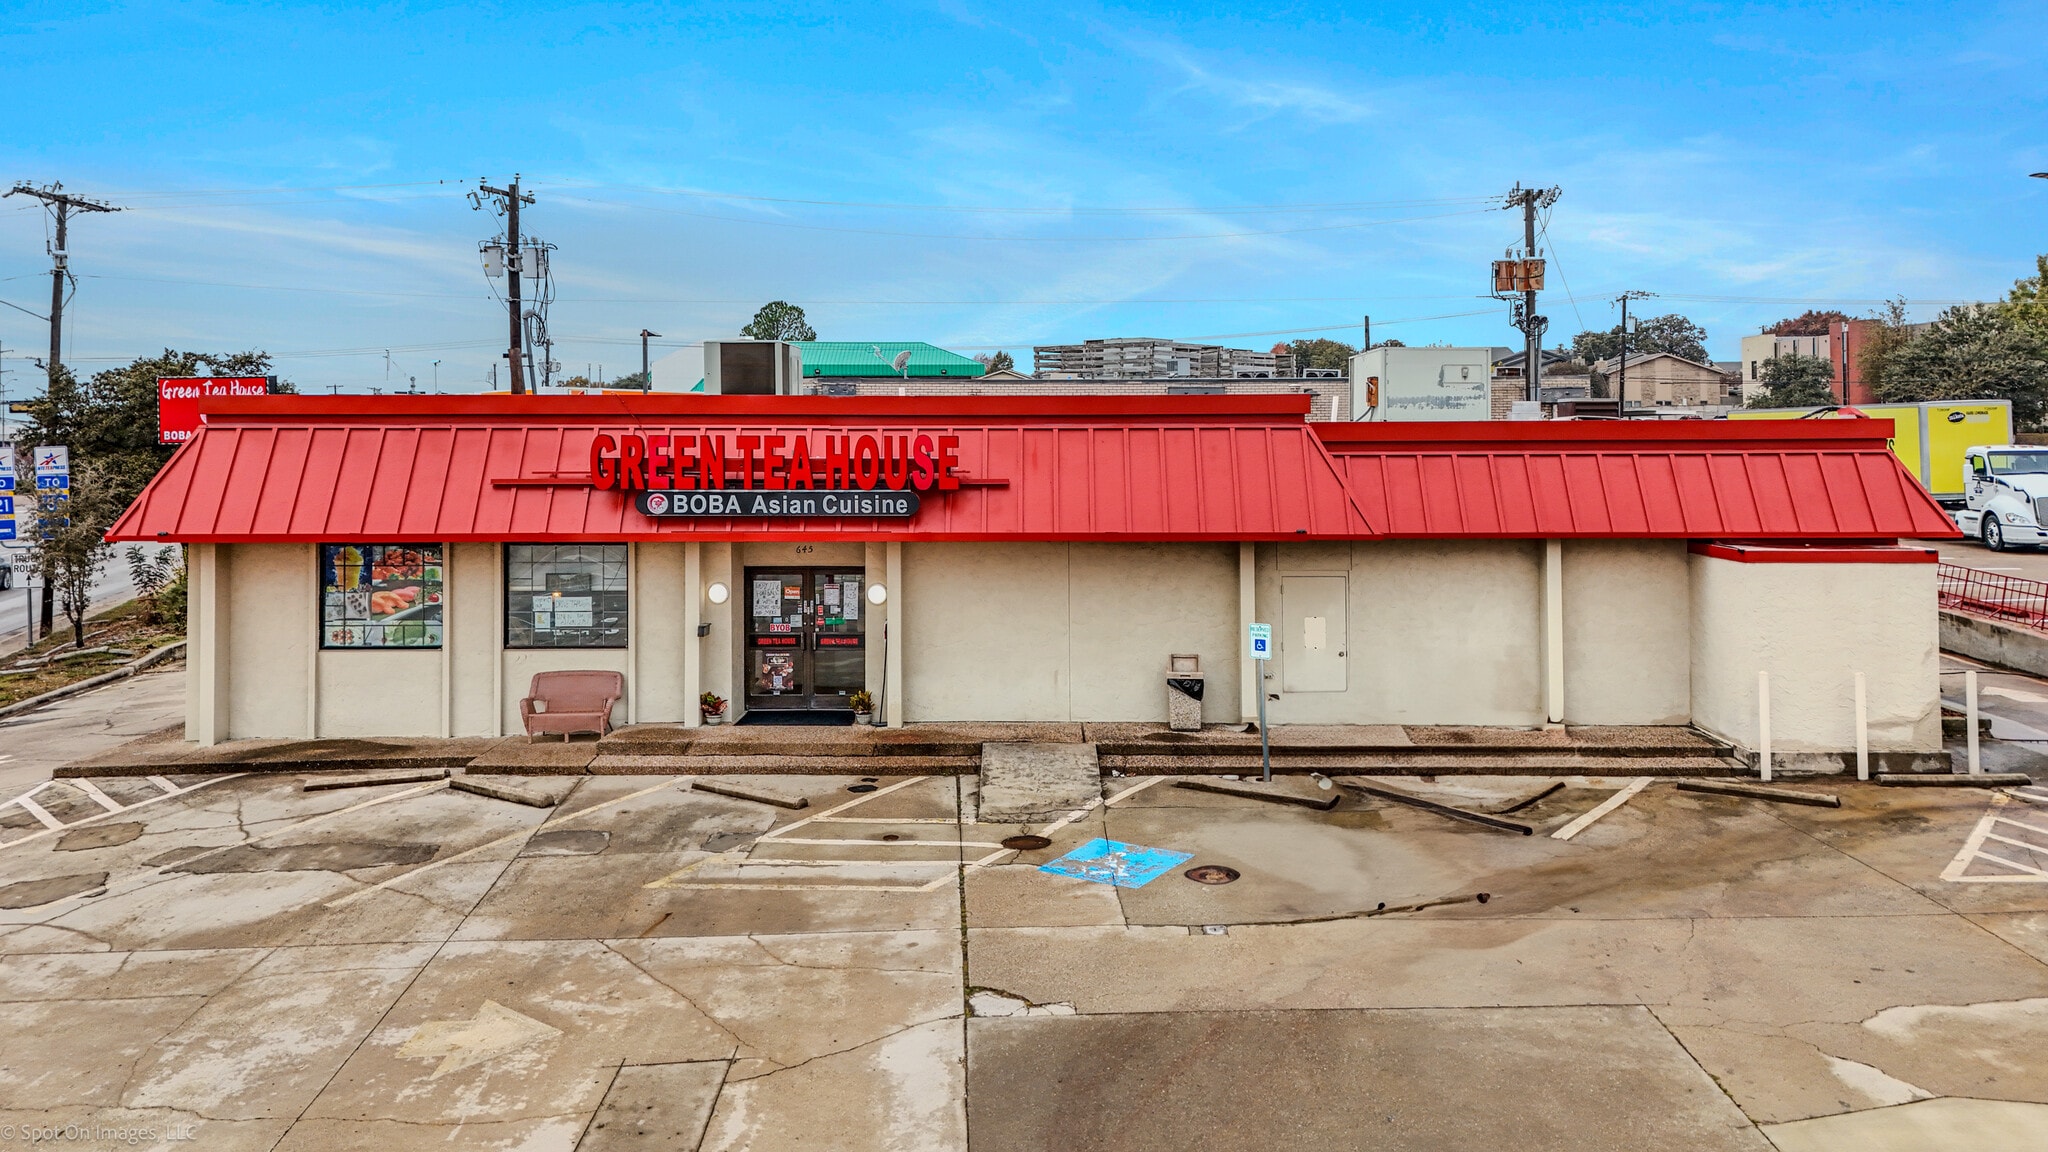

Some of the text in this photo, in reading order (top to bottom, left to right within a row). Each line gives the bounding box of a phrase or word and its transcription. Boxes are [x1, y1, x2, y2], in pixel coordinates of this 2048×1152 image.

[162, 380, 265, 399] Green Tea House
[164, 431, 192, 440] BOBA
[590, 434, 960, 490] GREEN TEA HOUSE
[44, 478, 60, 487] TO
[673, 495, 908, 515] BOBA Asian Cuisine
[796, 545, 814, 553] 645
[770, 624, 791, 632] BYOB
